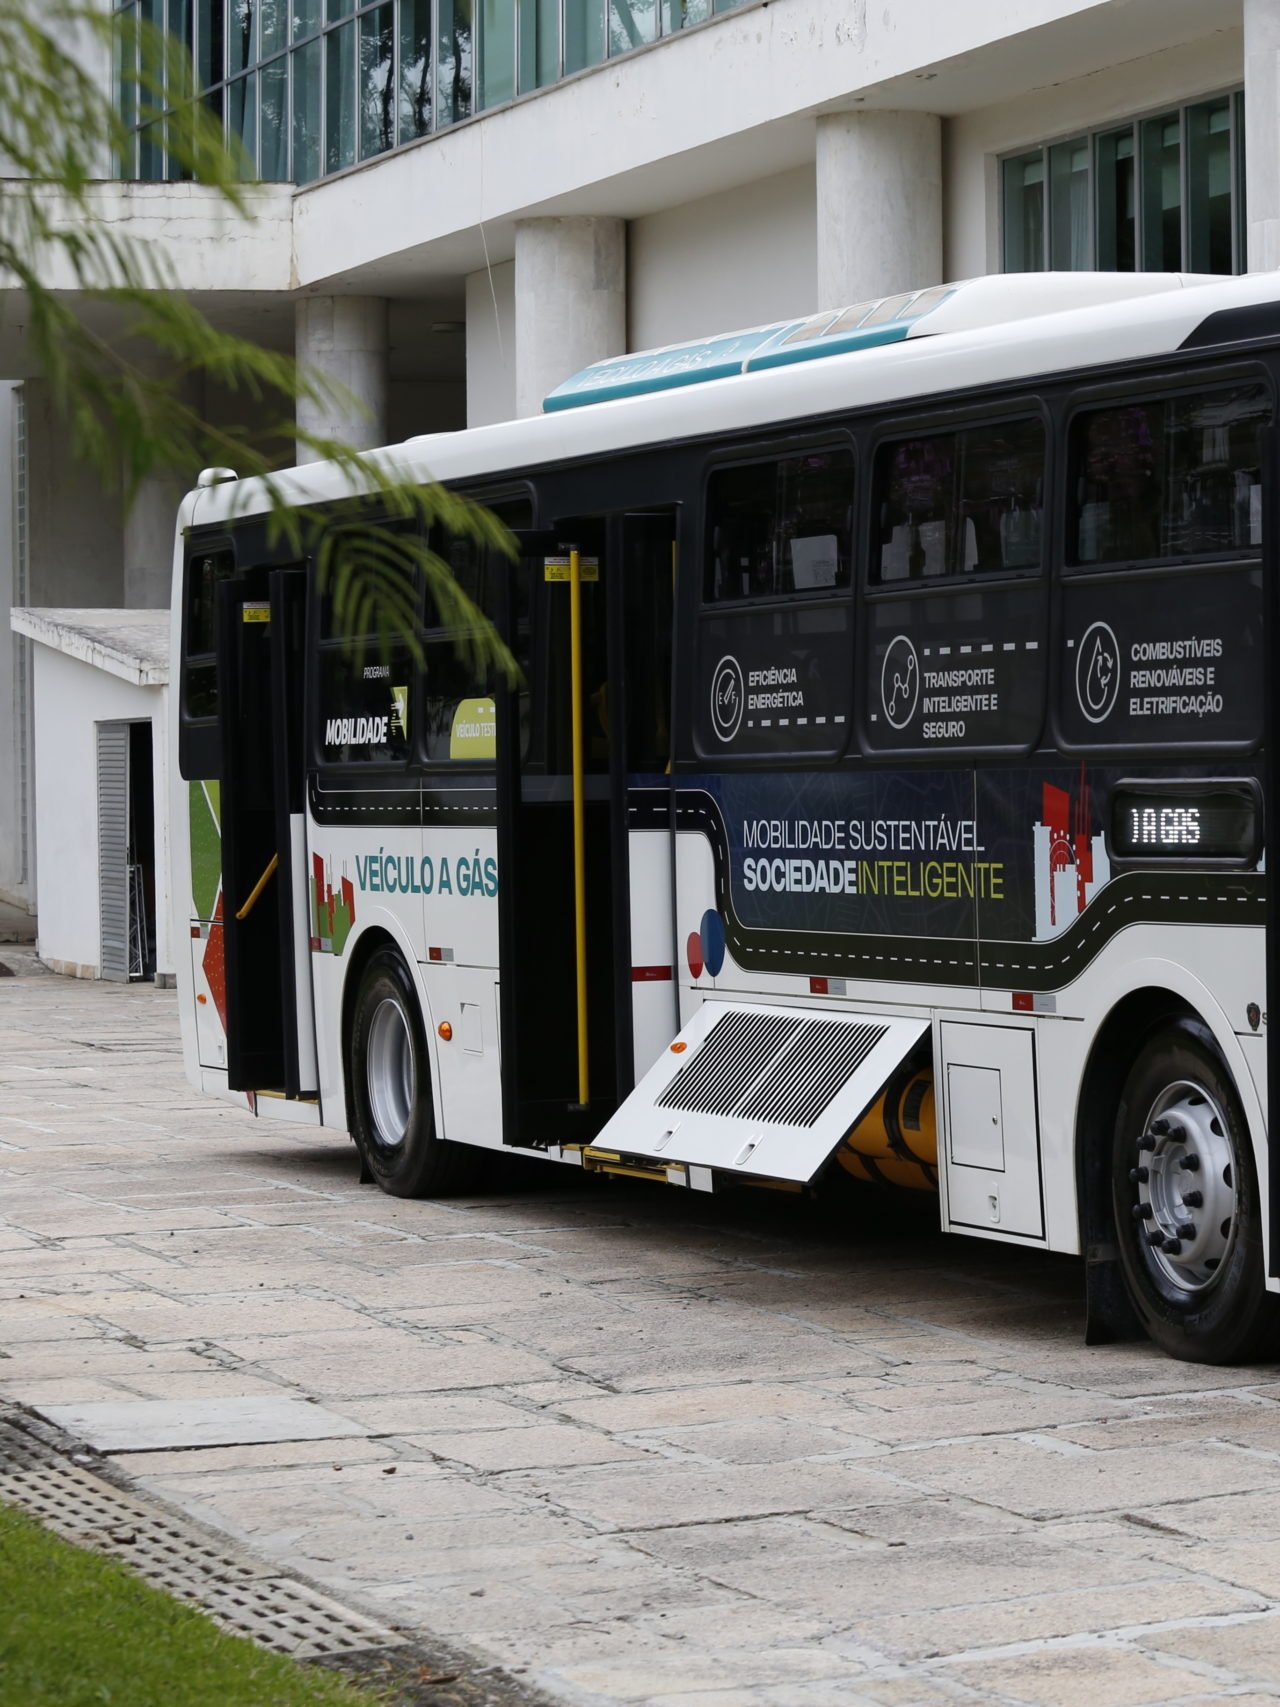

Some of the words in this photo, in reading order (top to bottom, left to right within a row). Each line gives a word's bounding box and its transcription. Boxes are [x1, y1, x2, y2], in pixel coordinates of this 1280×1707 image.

[1131, 636, 1223, 661] COMBUSTÍVEIS
[748, 666, 797, 686] EFICIÊNCIA
[924, 669, 995, 688] TRANSPORTE
[1130, 665, 1205, 689] RENOVÁVEIS
[1206, 667, 1215, 685] E
[748, 689, 804, 709] ENERGÉTICA
[923, 694, 989, 714] INTELIGENTE
[990, 694, 998, 710] E
[1129, 691, 1223, 718] ELETRIFICAÇÃO
[325, 716, 389, 746] MOBILIDADE
[923, 721, 965, 738] SEGURO
[743, 820, 846, 850] MOBILIDADE
[849, 813, 985, 851] SUSTENTÁVEL
[1160, 808, 1200, 843] GAS
[355, 846, 434, 895] VEÍCULO
[438, 857, 453, 895] A
[456, 848, 499, 898] GÁS
